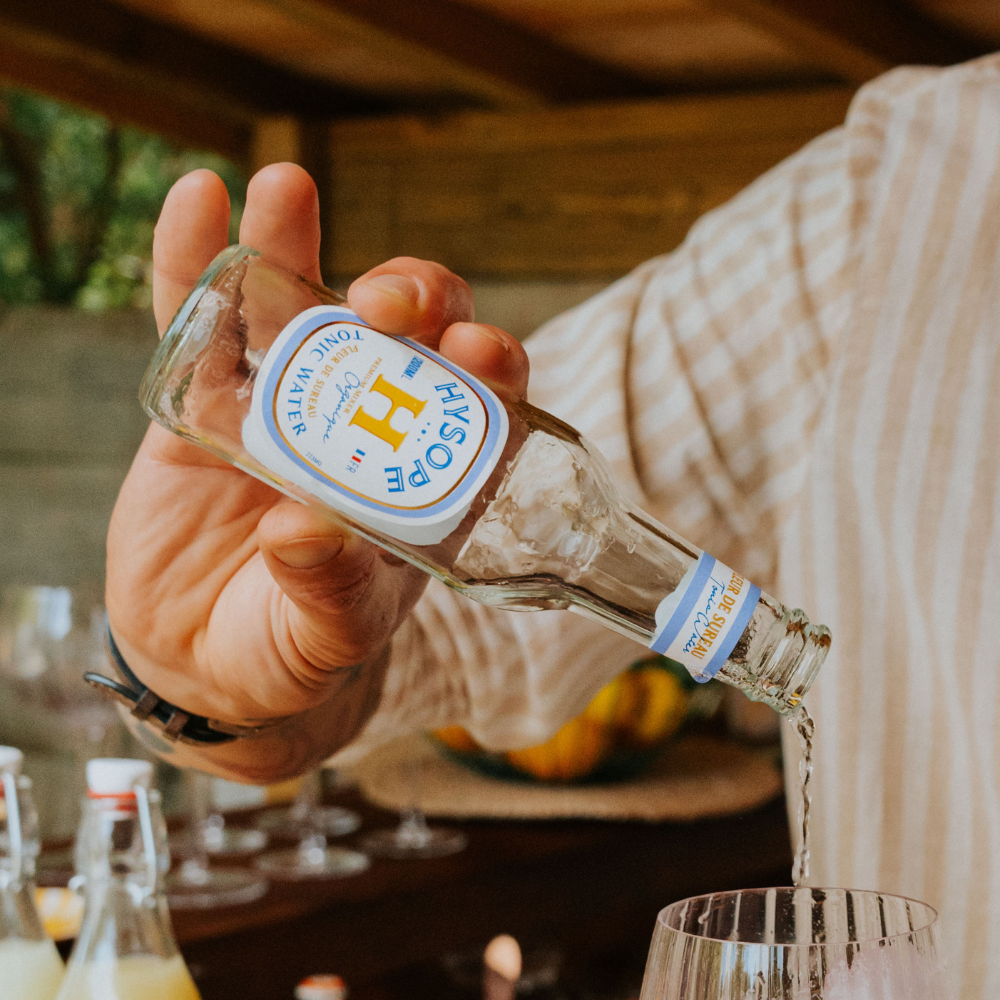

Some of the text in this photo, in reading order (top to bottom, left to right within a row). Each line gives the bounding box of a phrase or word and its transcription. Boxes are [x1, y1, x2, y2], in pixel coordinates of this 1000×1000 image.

[287, 330, 364, 436] TONIC WATER
[307, 345, 359, 418] FLEUR DE SUREAU
[343, 356, 383, 414] PREMIUM MIXER
[401, 356, 423, 381] 200ML
[322, 371, 361, 443] Organique
[347, 374, 428, 453] H
[384, 382, 470, 493] HYSOPE
[345, 460, 360, 474] FR
[690, 572, 745, 660] LEUR DE SUREAU
